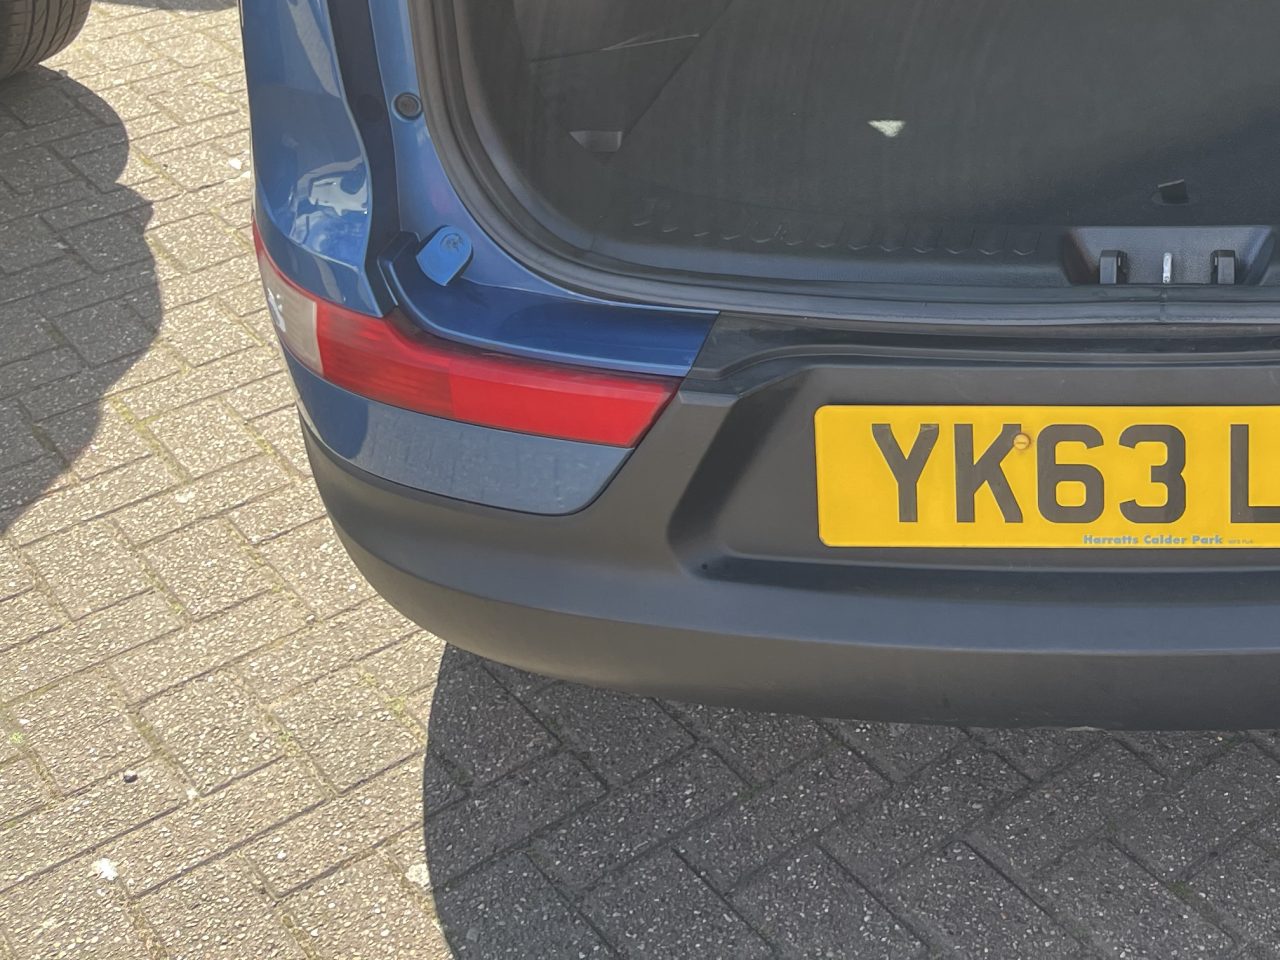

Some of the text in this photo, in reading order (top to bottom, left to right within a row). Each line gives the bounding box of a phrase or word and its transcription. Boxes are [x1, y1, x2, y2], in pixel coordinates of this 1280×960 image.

[871, 423, 1187, 524] YK63
[1083, 535, 1139, 545] Harratts
[1143, 534, 1187, 545] Calder
[1192, 534, 1223, 545] Park
